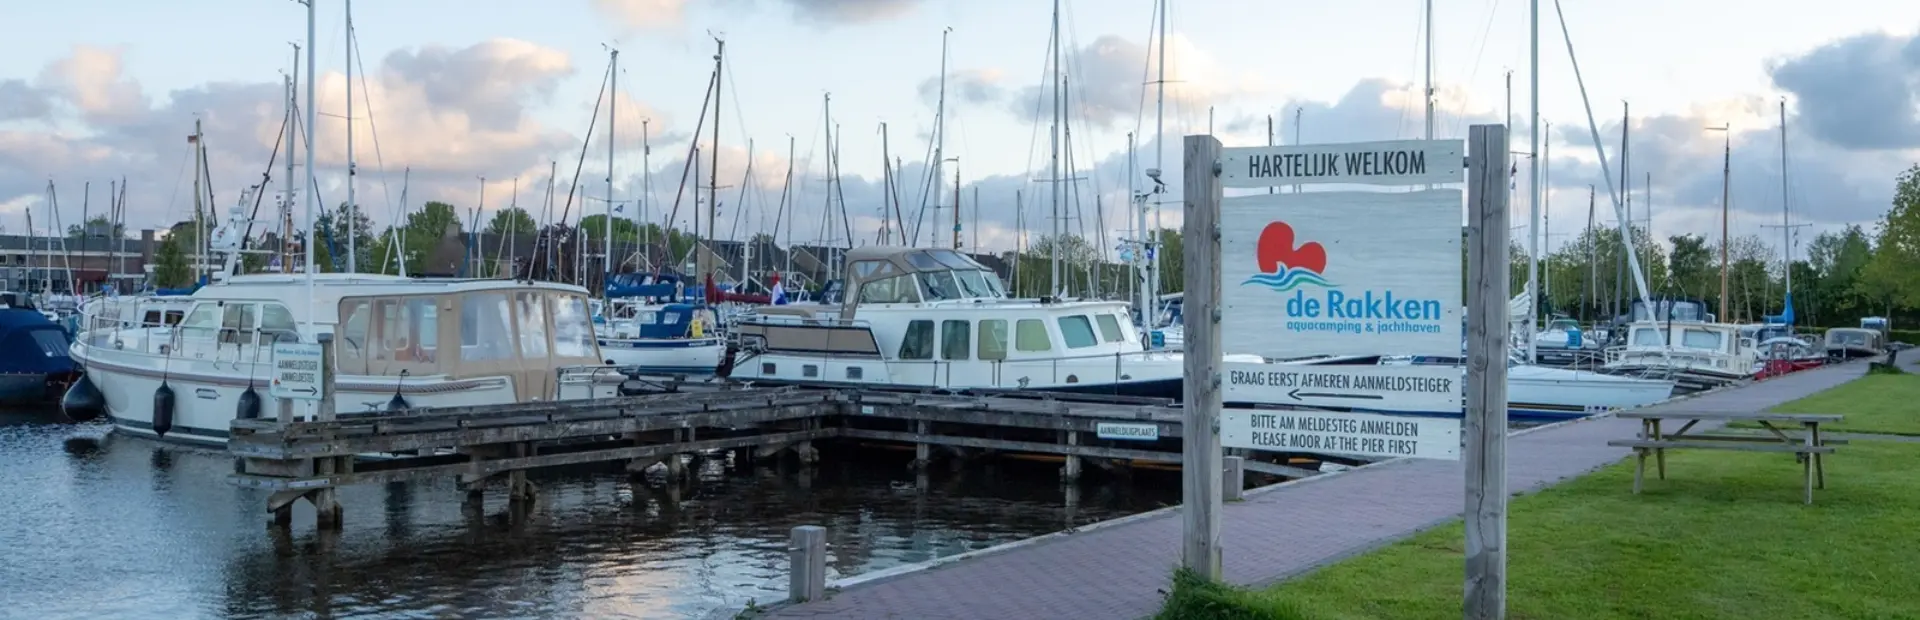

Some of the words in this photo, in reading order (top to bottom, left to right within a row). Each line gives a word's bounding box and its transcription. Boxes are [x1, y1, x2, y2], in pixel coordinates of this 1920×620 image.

[1249, 154, 1339, 177] HARTELIJK
[1345, 150, 1426, 176] WELKOM
[1286, 290, 1320, 318] de
[1327, 290, 1441, 320] Rakken
[1286, 320, 1362, 333] aquacamping
[1365, 322, 1374, 332] &
[1377, 321, 1441, 335] jachthaven
[1230, 370, 1265, 386] GRAAG
[1268, 371, 1299, 387] EERST
[1301, 373, 1350, 389] AFMEREN
[1353, 375, 1451, 393] AANMELDSTEIGER
[1251, 415, 1276, 429] BITTE
[1279, 416, 1295, 430] AM
[1298, 417, 1357, 433] MELDESTEG
[1360, 420, 1419, 437] ANMELDEN
[1252, 432, 1286, 447] PLEASE
[1289, 434, 1321, 448] MOOR
[1323, 436, 1337, 450] AT
[1338, 436, 1359, 451] THE
[1362, 438, 1386, 453] PIER
[1388, 439, 1418, 455] FIRST
